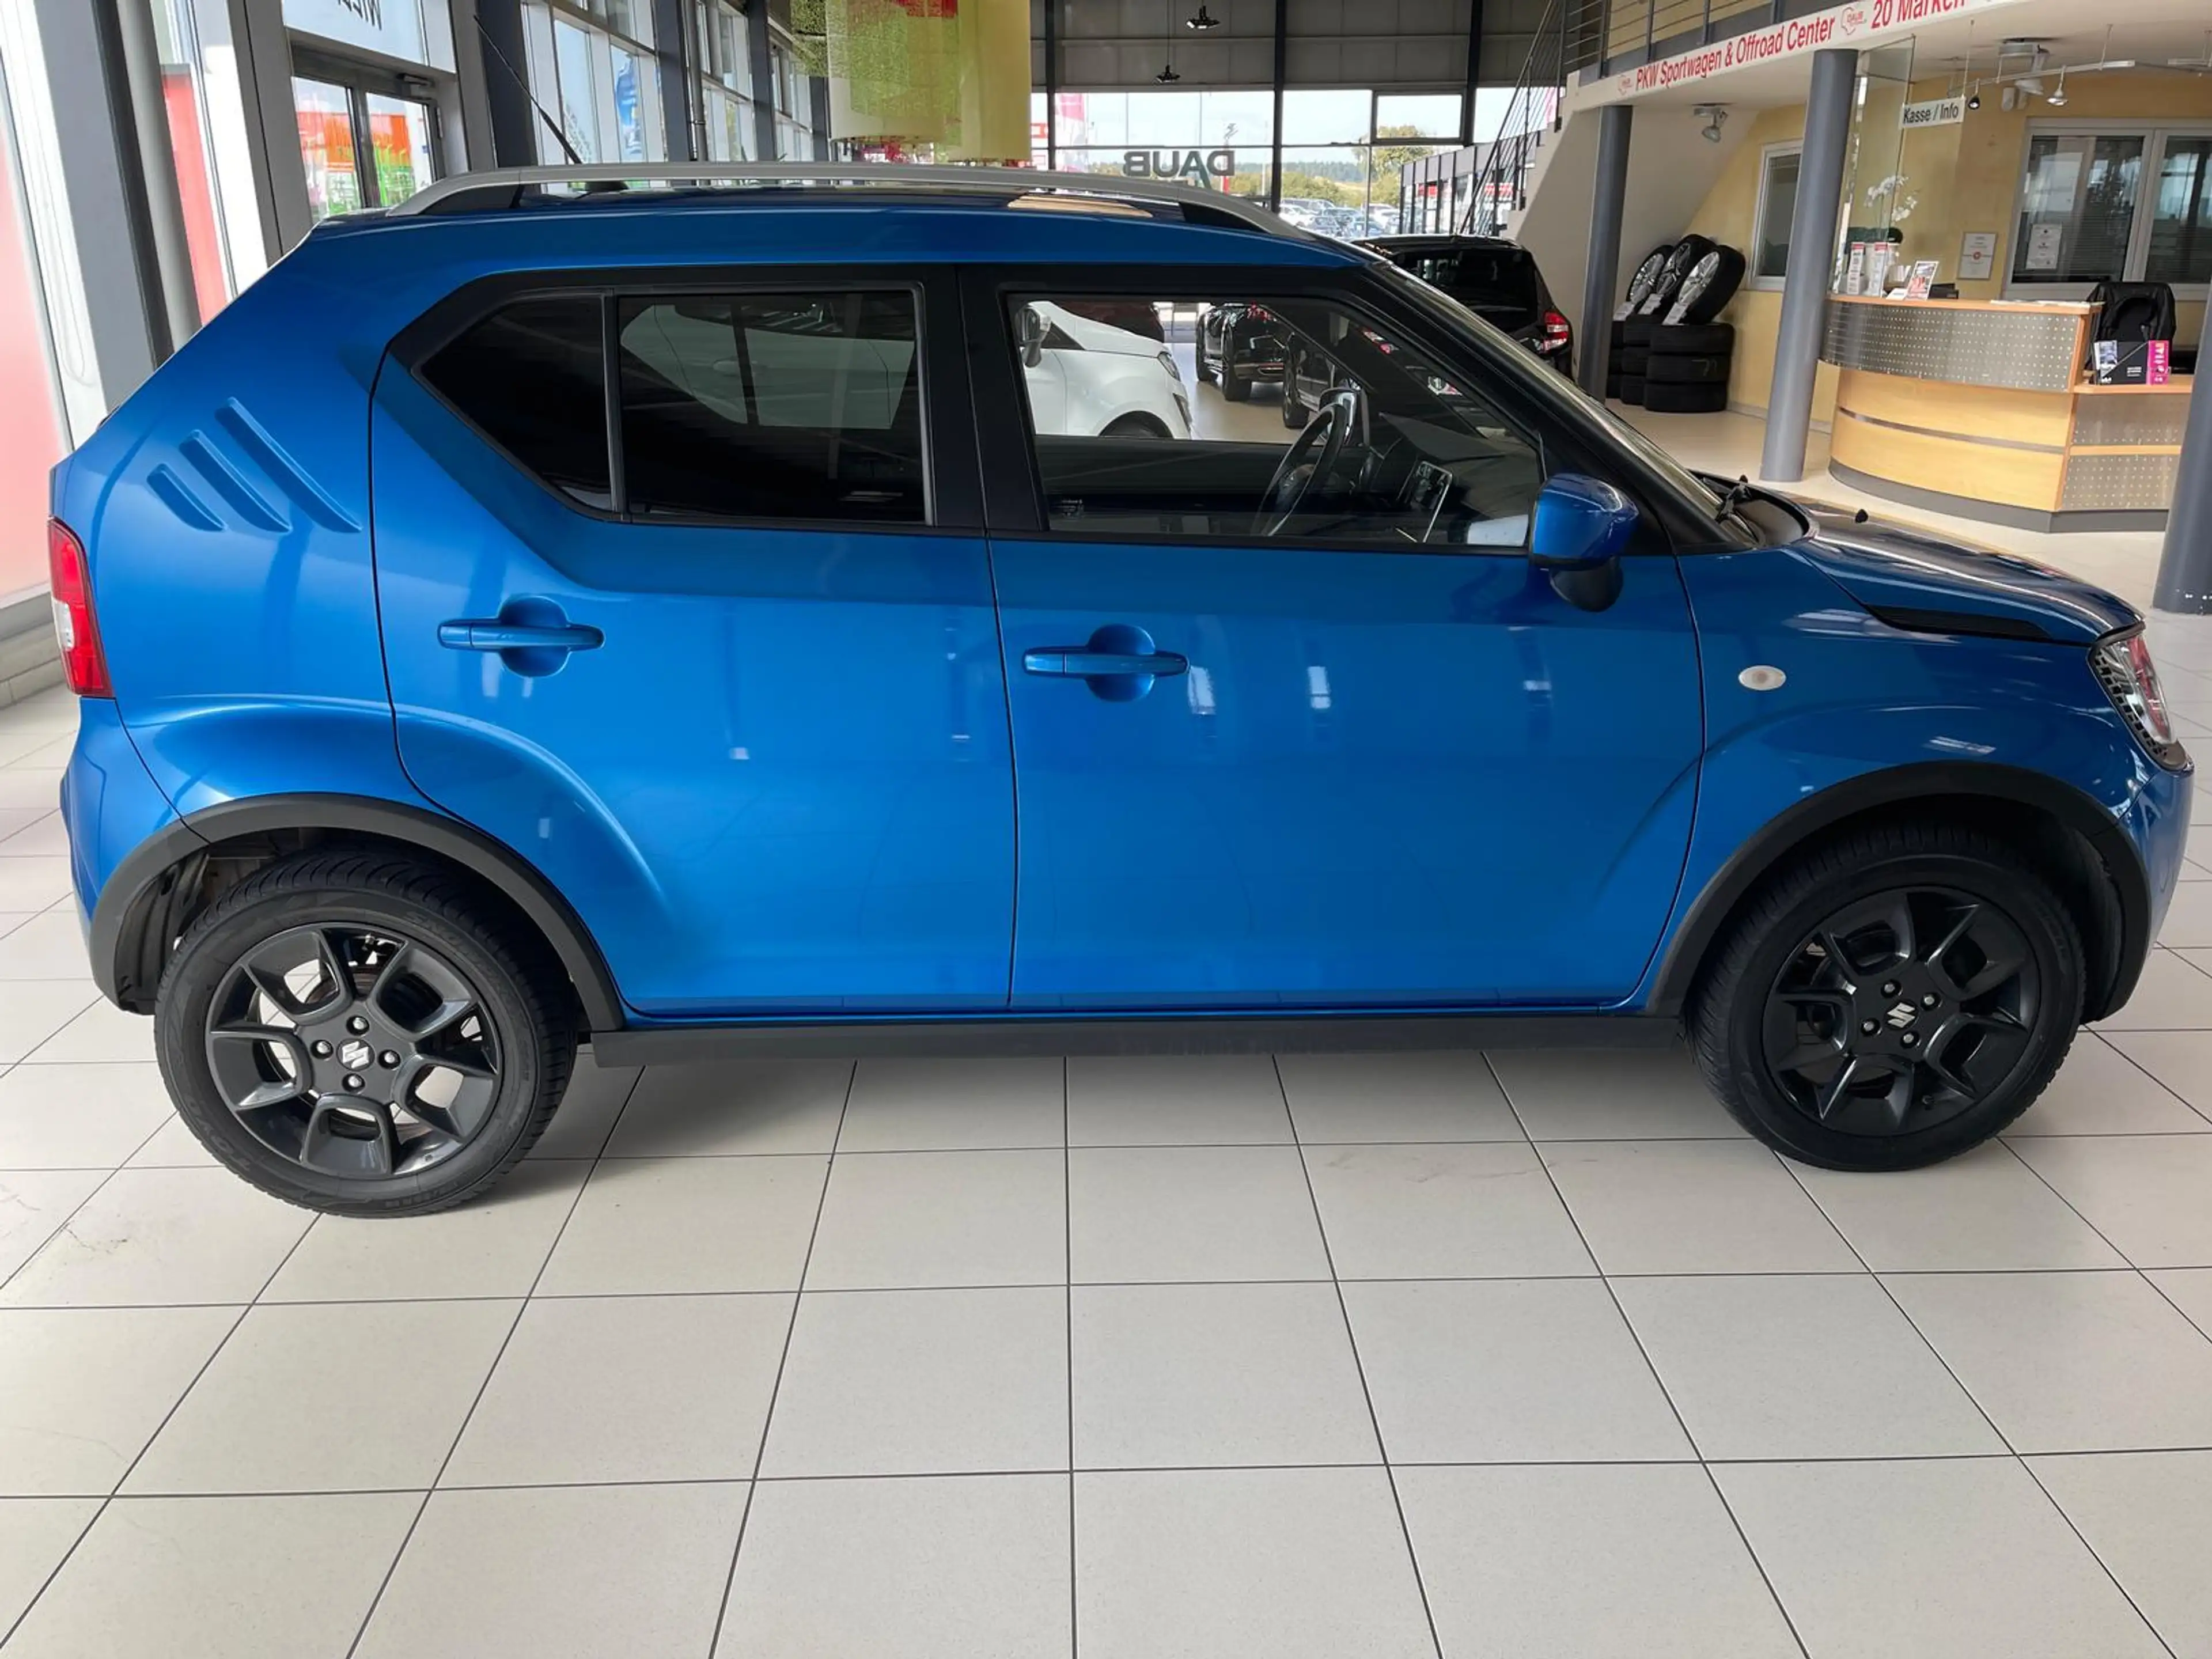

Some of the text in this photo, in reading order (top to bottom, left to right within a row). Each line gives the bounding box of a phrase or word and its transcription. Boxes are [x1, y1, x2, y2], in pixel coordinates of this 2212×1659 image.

[1870, 0, 1892, 29] 20
[1636, 17, 1835, 90] PKW Sportwagen & Offroad Center
[1903, 108, 1931, 124] Kasse
[1940, 103, 1959, 120] Info
